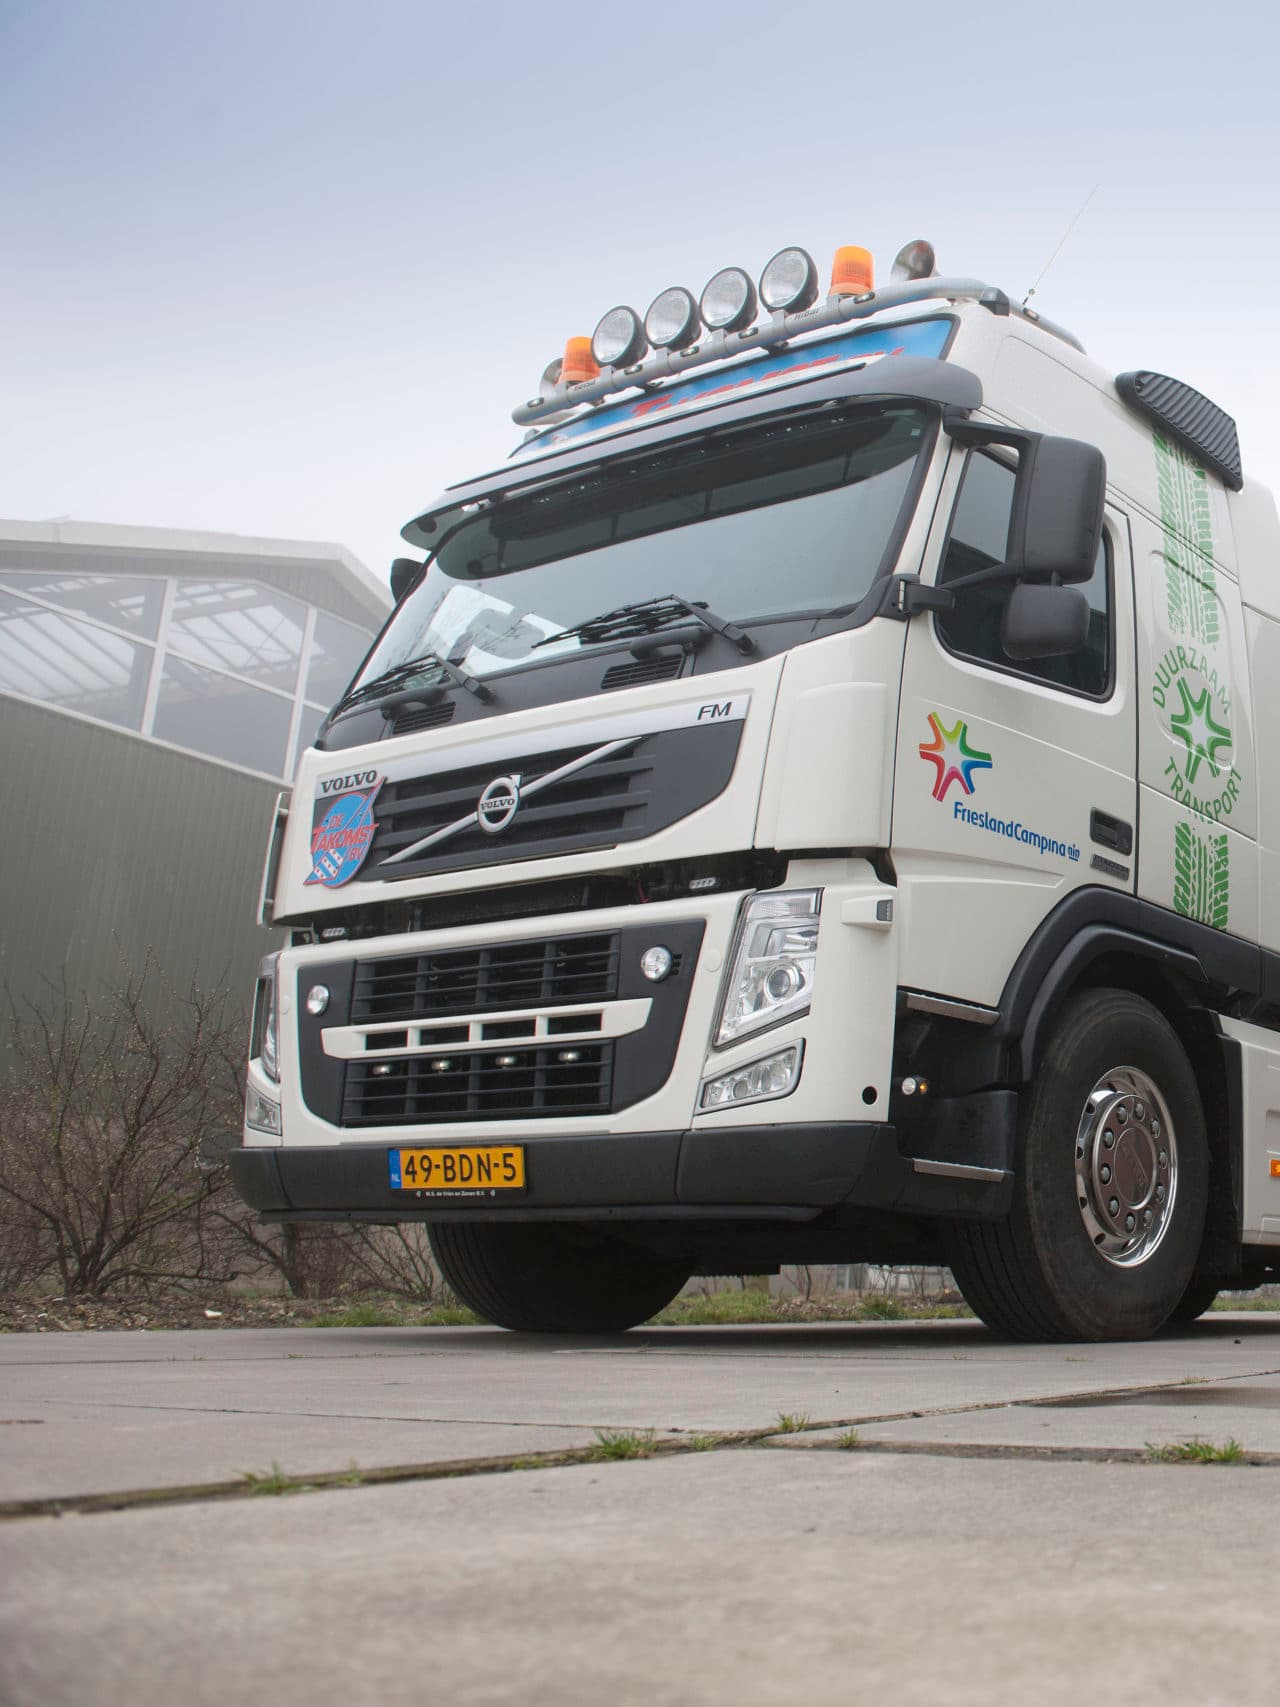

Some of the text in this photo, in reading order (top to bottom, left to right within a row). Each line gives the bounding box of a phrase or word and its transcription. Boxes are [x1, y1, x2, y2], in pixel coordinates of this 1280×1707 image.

[1152, 645, 1231, 715] DUURZAAM
[697, 702, 732, 720] FM
[320, 769, 378, 793] VOLVO
[1164, 756, 1242, 824] TRANSPORT
[480, 798, 515, 810] VOLVO
[327, 813, 345, 828] DE
[953, 801, 1066, 857] FrieslandCampina
[405, 1152, 516, 1183] 49-BDN-5
